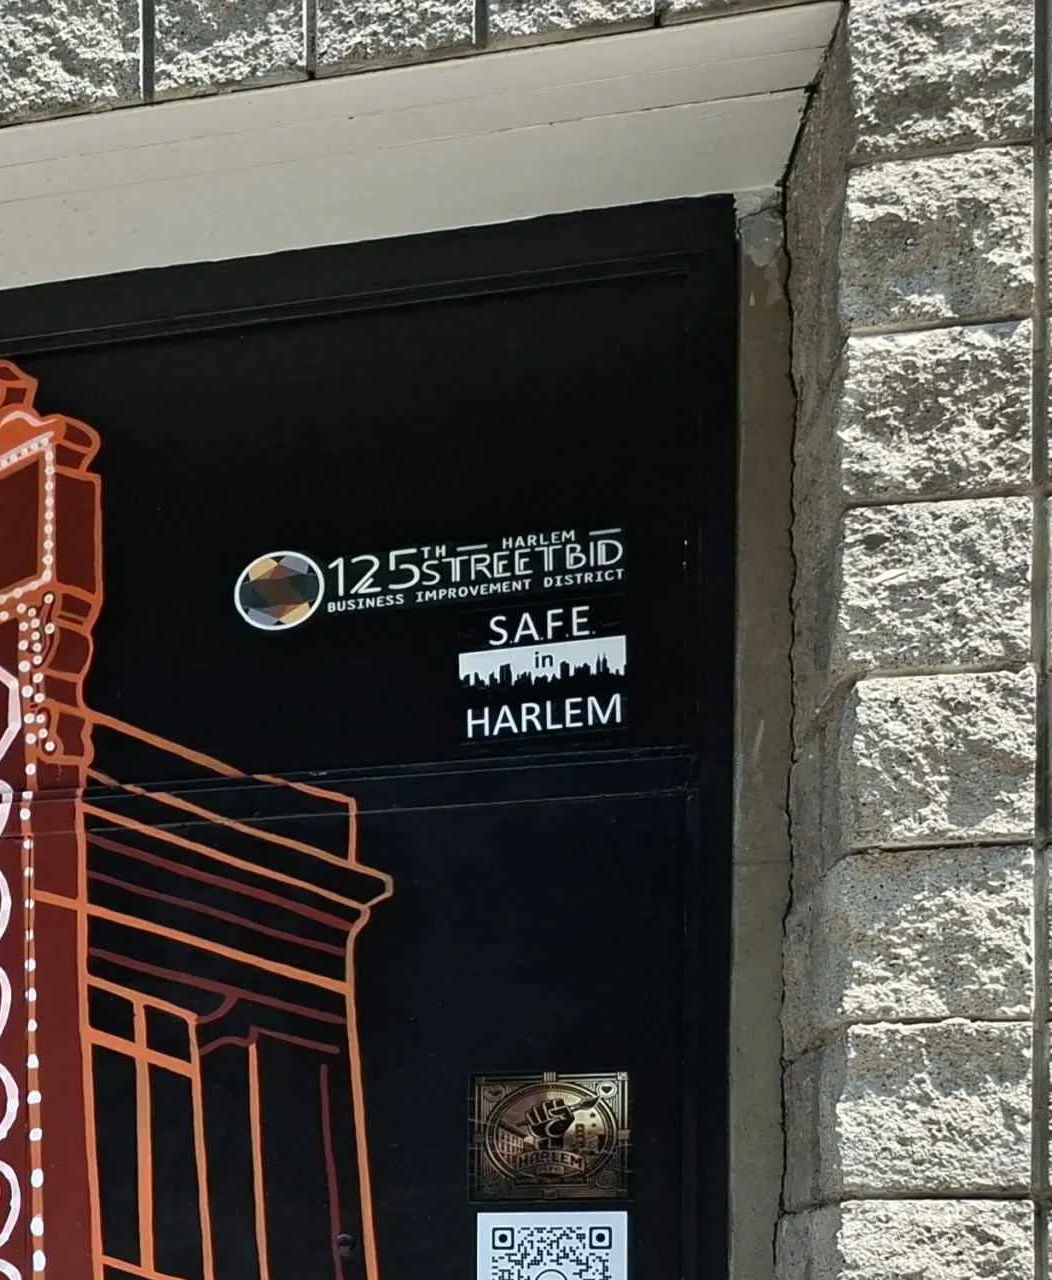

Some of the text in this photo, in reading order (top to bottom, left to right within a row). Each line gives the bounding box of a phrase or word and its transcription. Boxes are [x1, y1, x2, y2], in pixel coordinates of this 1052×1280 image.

[502, 529, 576, 550] HARLEM
[327, 568, 625, 613] BUSINESS IMPROVEMENT DISTRICT
[534, 650, 555, 669] in
[466, 692, 622, 738] HARLEM
[518, 1151, 583, 1170] HARLEM
